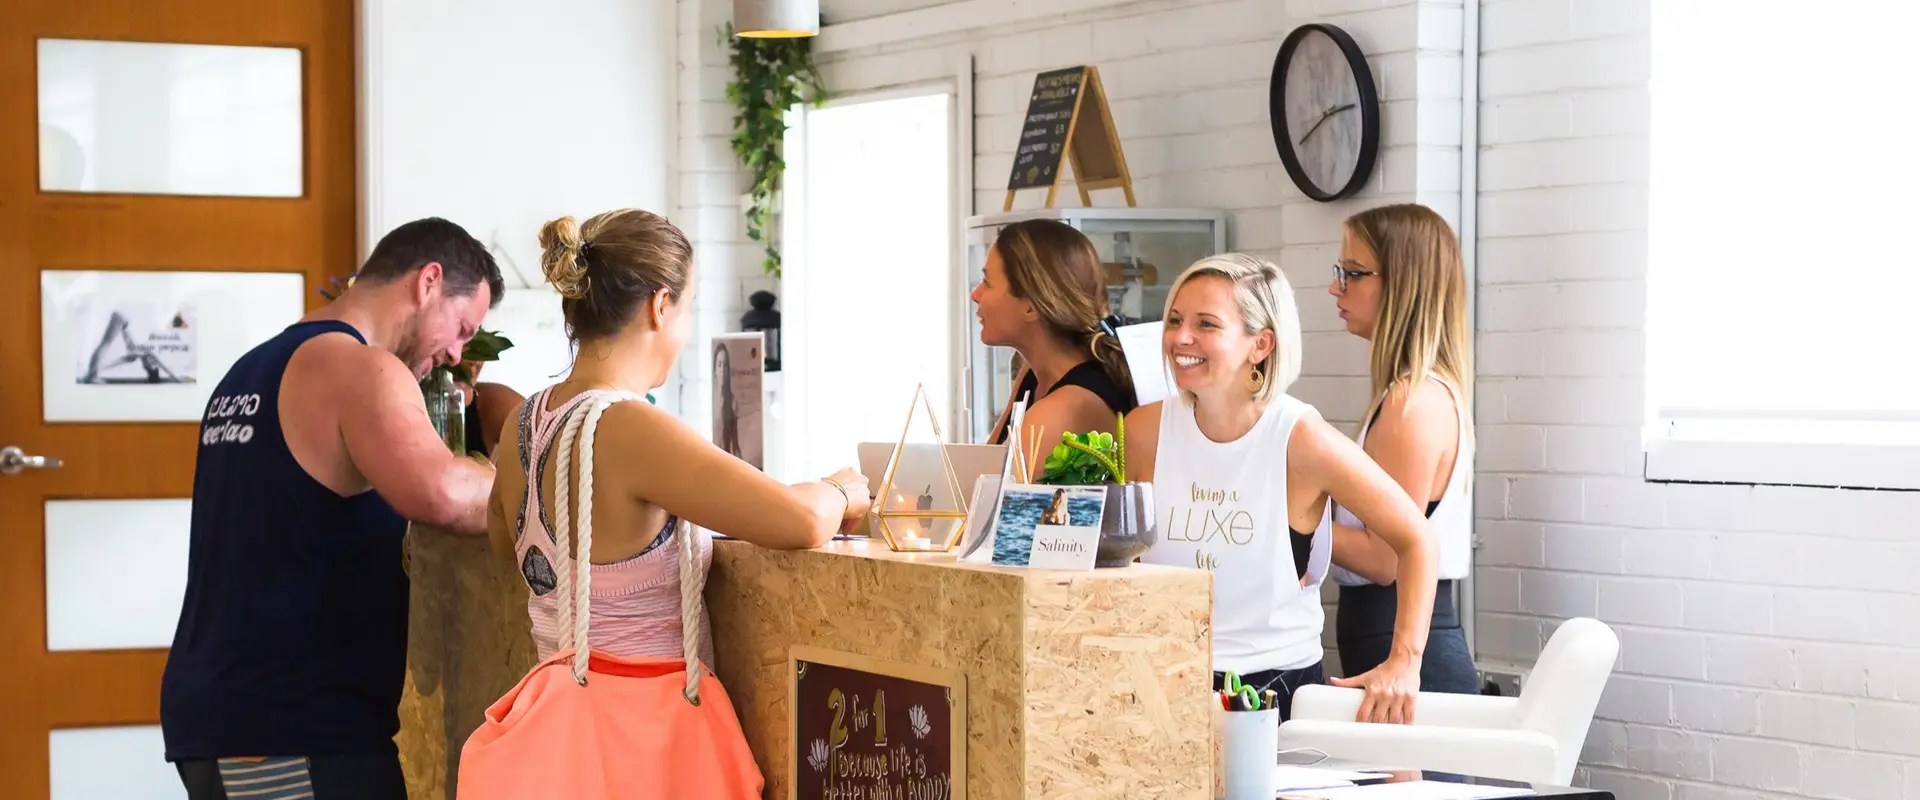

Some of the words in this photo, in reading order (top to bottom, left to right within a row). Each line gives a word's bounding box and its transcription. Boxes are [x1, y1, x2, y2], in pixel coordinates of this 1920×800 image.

[1191, 481, 1225, 506] living
[1229, 490, 1240, 502] a
[1037, 538, 1087, 557] Salinity.
[1195, 548, 1221, 570] life
[828, 688, 849, 752] 2
[852, 693, 869, 732] for
[872, 688, 888, 747] 1
[891, 742, 911, 778] life
[915, 747, 927, 779] is
